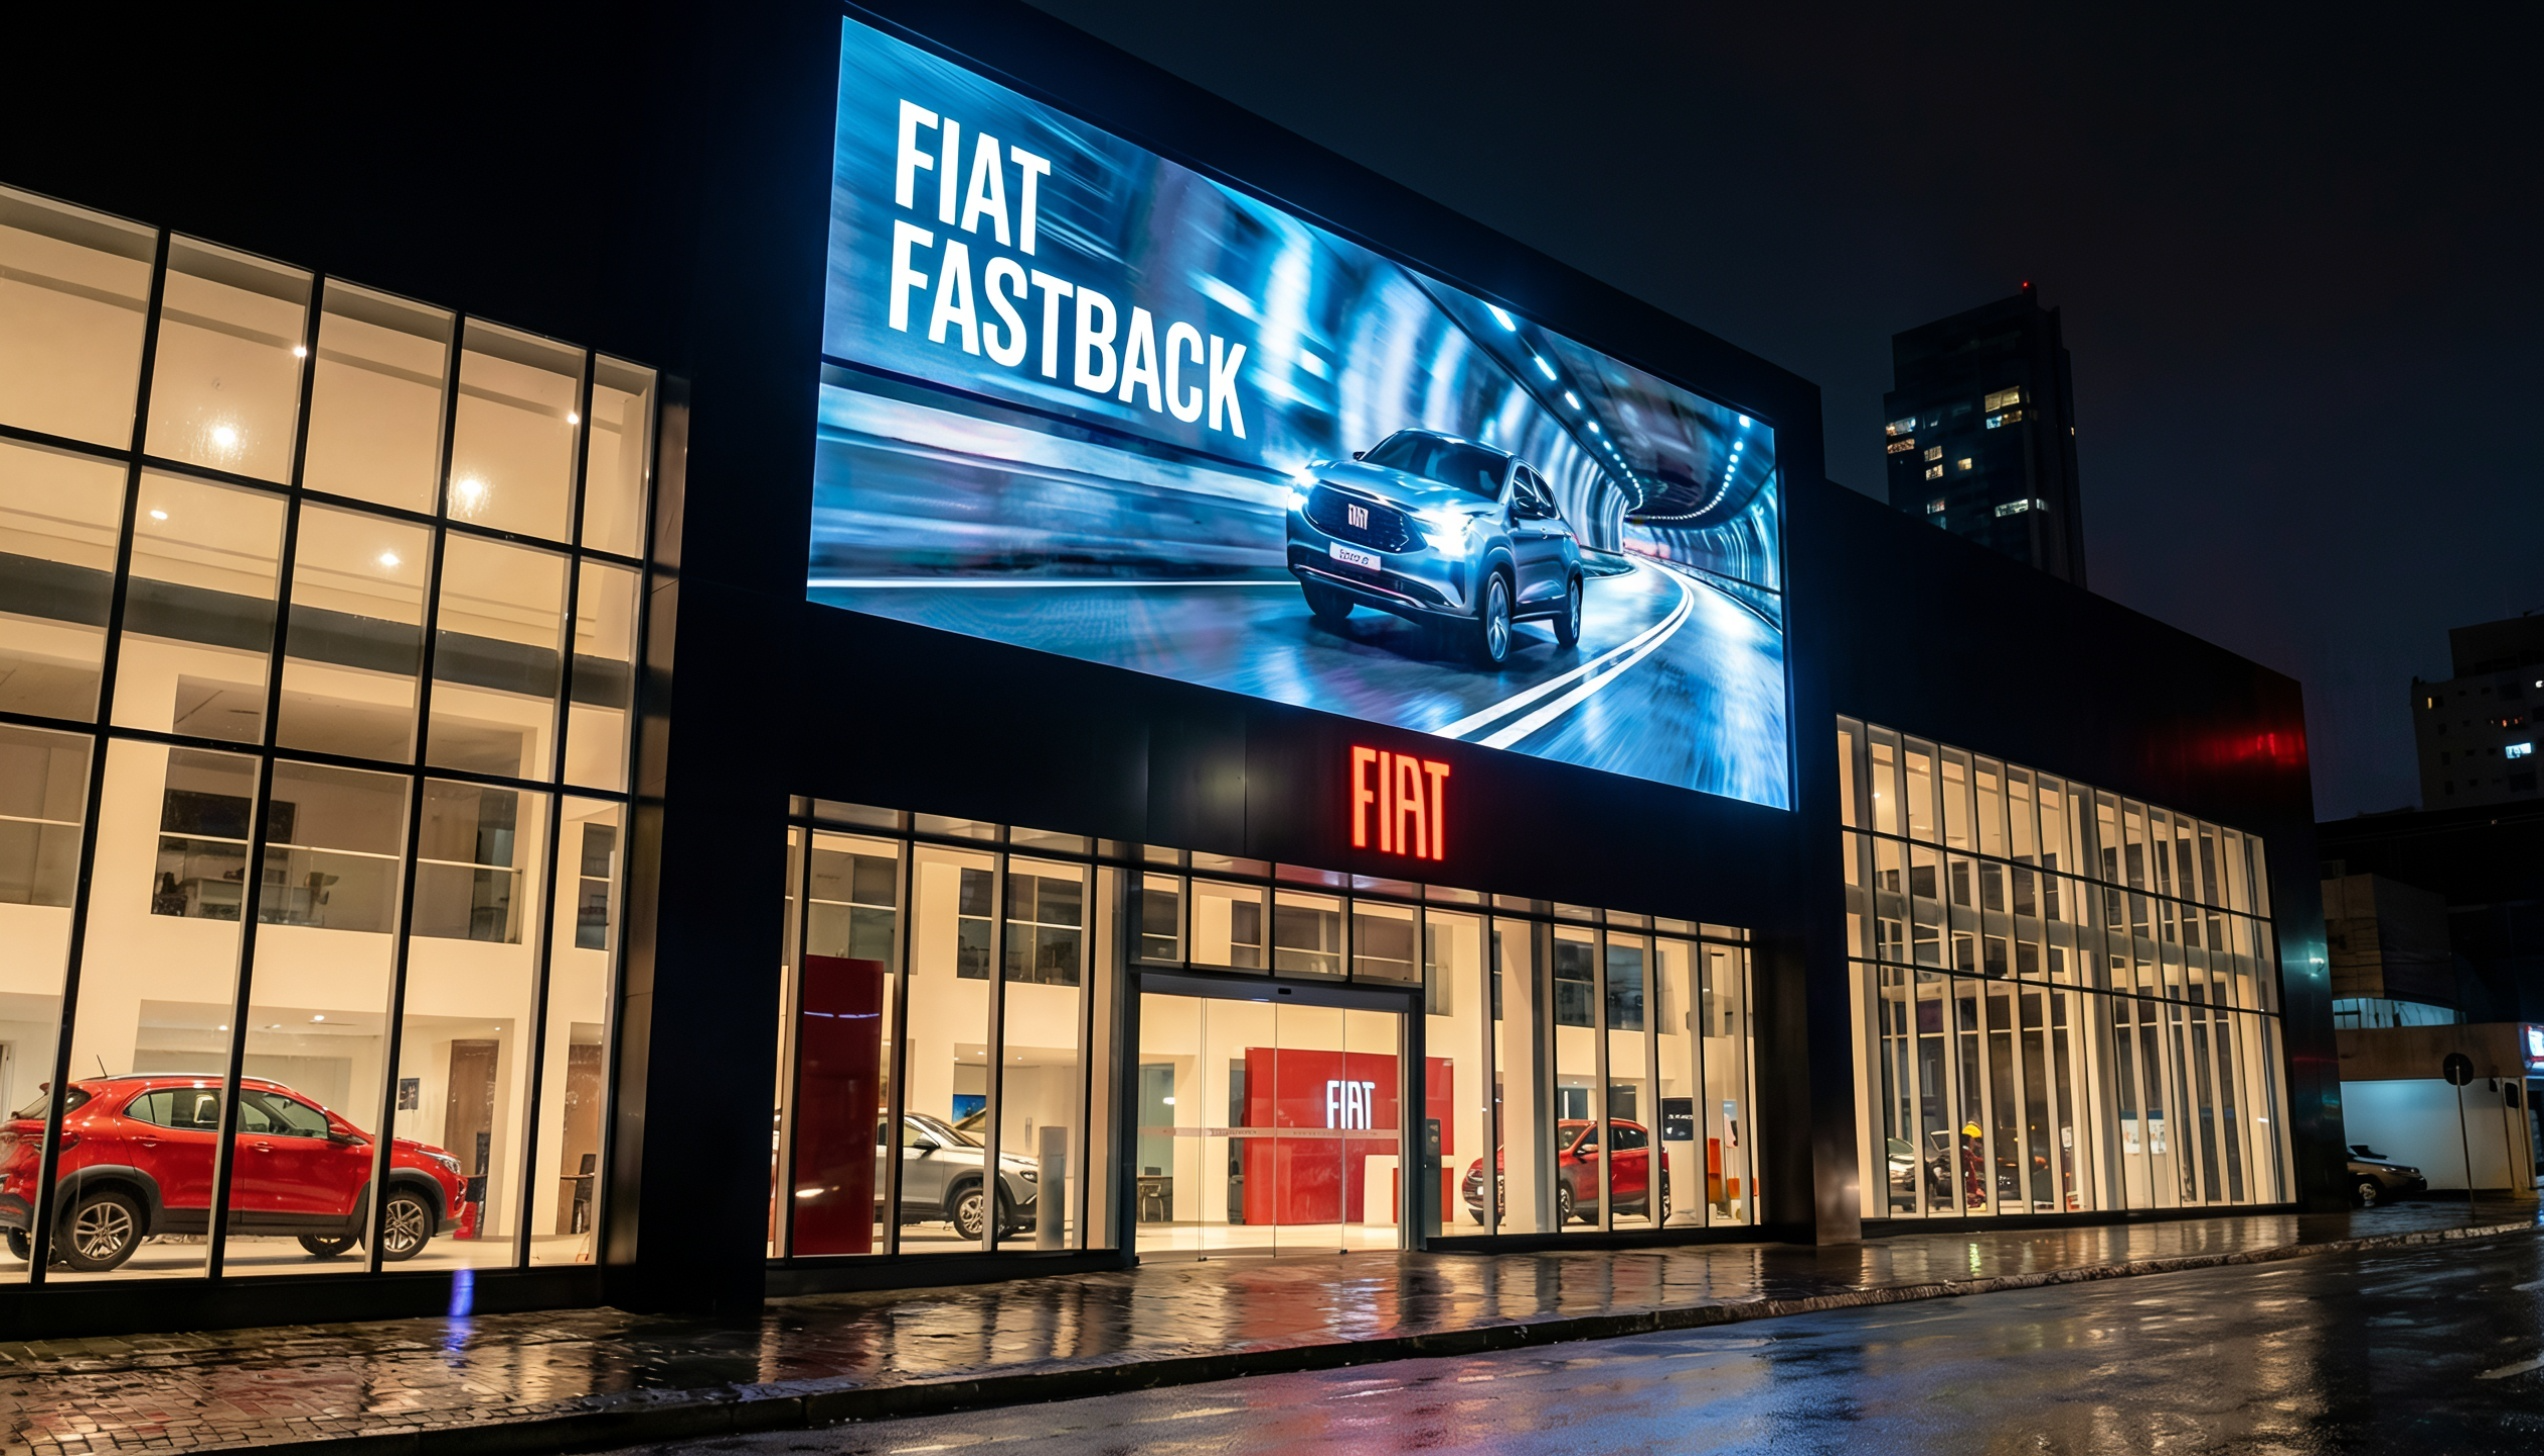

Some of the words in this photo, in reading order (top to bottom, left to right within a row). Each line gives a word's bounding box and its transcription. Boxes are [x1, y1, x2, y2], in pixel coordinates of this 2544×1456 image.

[895, 98, 1051, 256] FIAT
[889, 219, 1247, 440] FASTBACK
[1351, 745, 1450, 861] FIAT
[1326, 1079, 1376, 1130] FIAT
